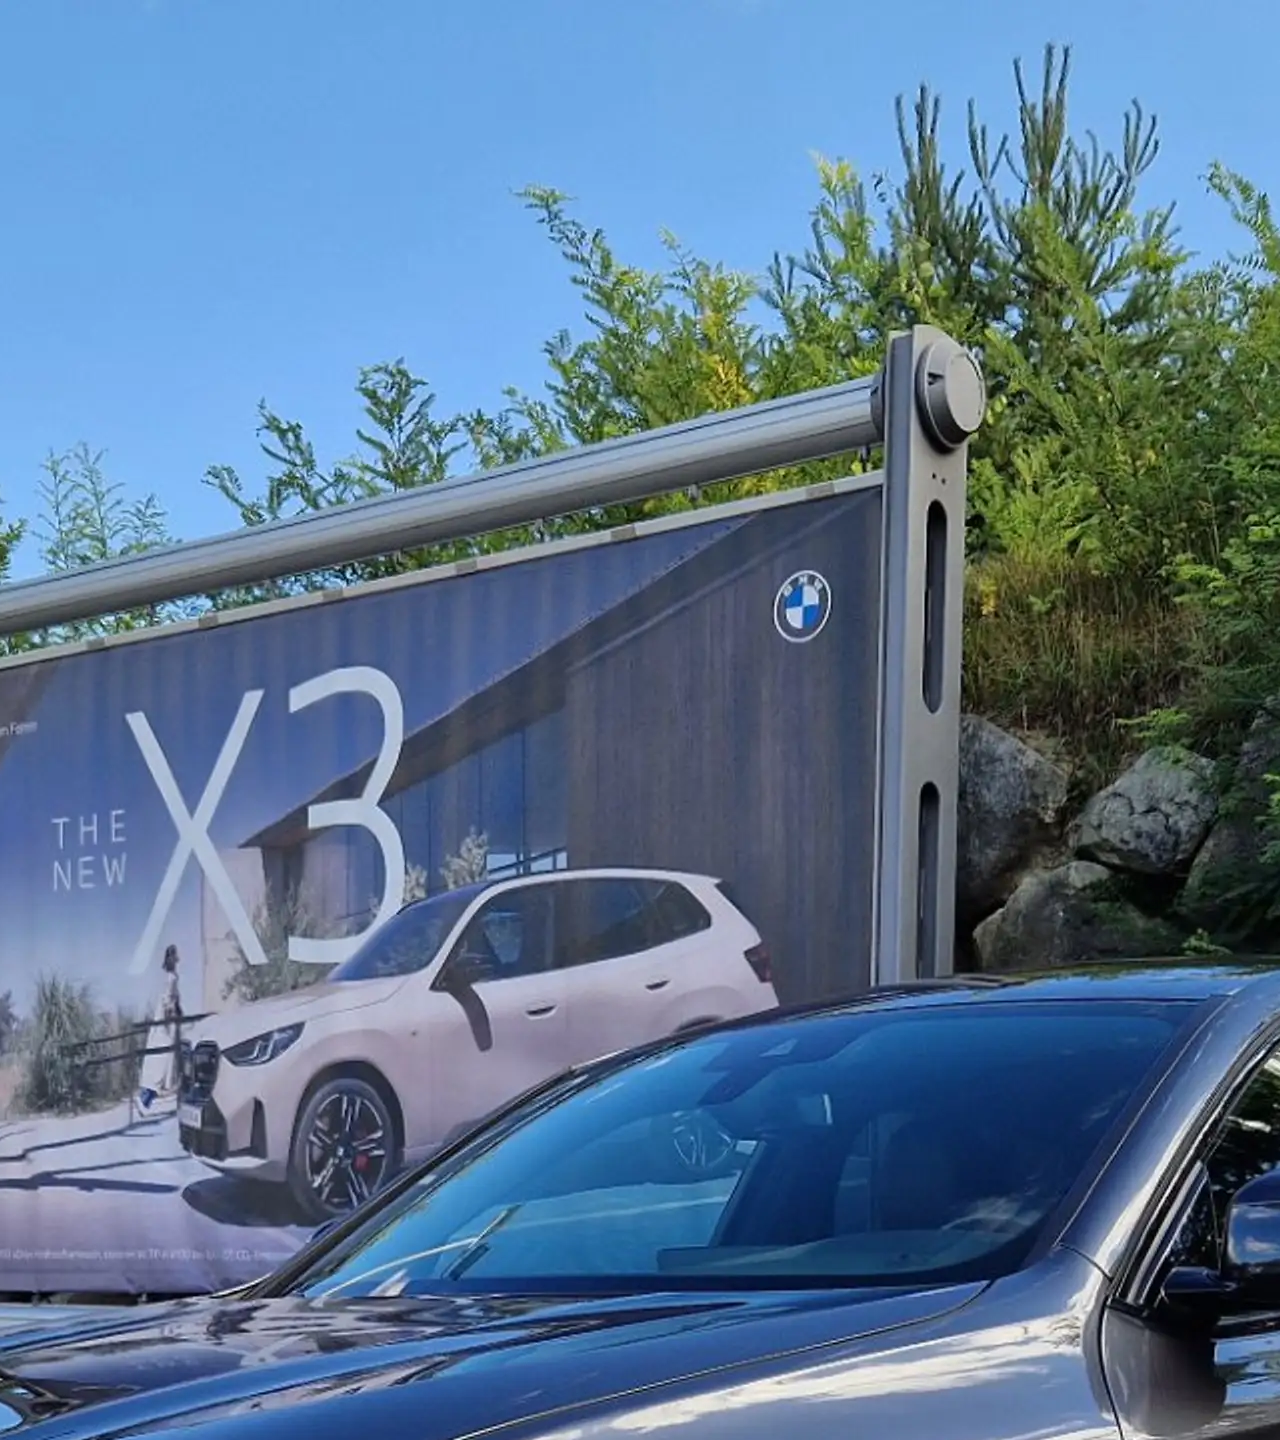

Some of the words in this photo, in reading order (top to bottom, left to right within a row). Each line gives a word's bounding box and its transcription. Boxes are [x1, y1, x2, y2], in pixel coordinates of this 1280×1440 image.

[51, 810, 126, 849] THE
[125, 666, 405, 975] X3
[53, 852, 127, 891] NEW
